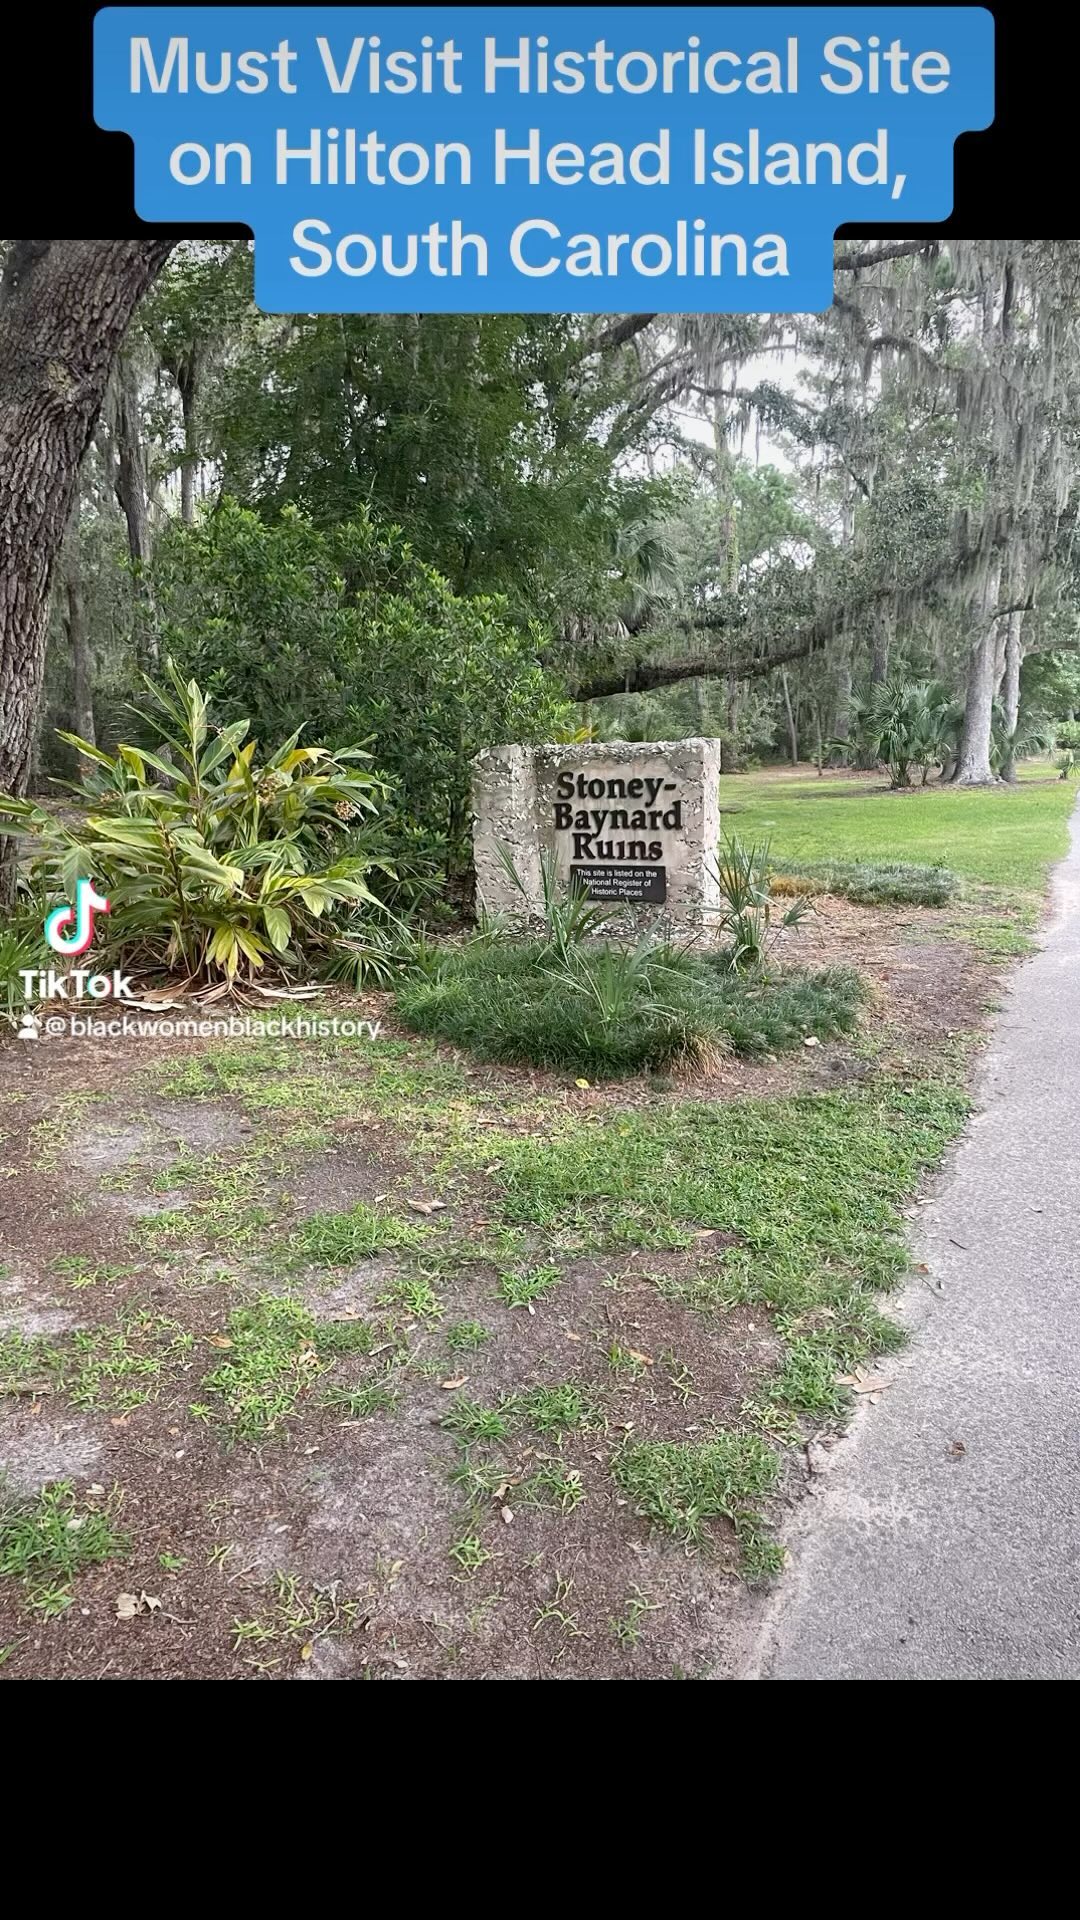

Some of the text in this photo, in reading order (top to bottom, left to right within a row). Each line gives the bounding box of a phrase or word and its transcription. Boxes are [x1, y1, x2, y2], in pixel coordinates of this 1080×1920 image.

[556, 771, 677, 807] Stoney-
[553, 799, 683, 837] Baynard
[572, 832, 664, 861] Ruins
[577, 868, 591, 877] This
[592, 869, 605, 877] site
[614, 869, 633, 877] listed
[644, 870, 658, 878] the
[583, 878, 652, 888] National Register of
[591, 887, 643, 897] Historic Places
